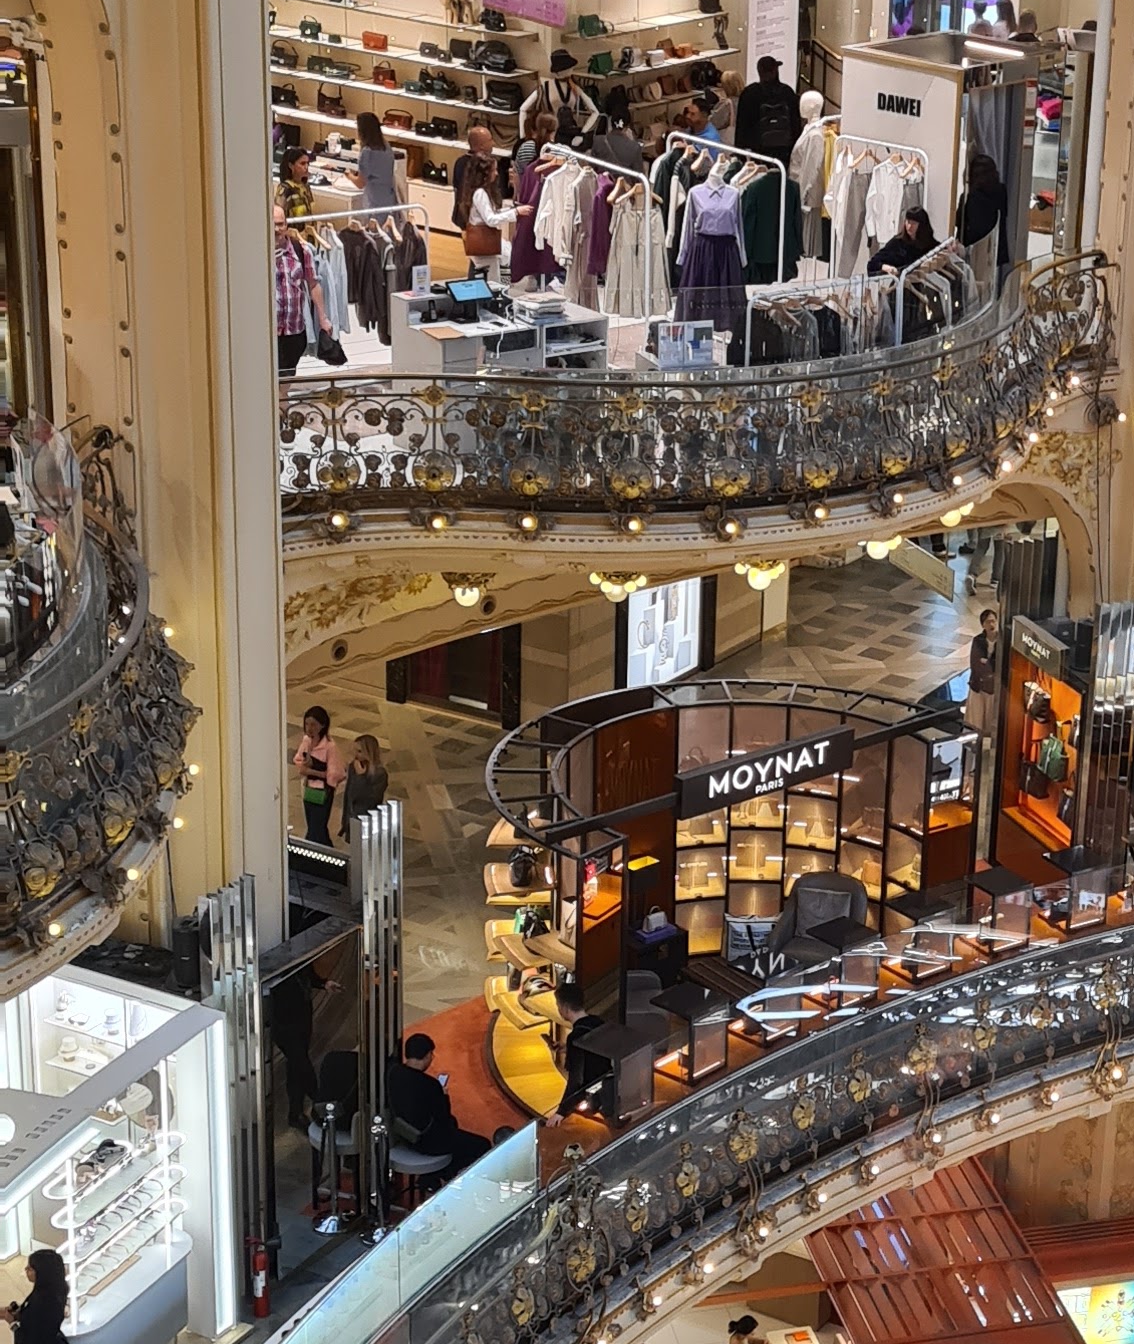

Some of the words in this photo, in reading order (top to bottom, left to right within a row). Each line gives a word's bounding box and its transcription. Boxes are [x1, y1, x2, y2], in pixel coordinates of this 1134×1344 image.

[877, 92, 921, 118] DAWEI
[1021, 632, 1051, 660] MOYNAT
[708, 740, 830, 799] MOYNAT
[755, 777, 784, 795] PARIS
